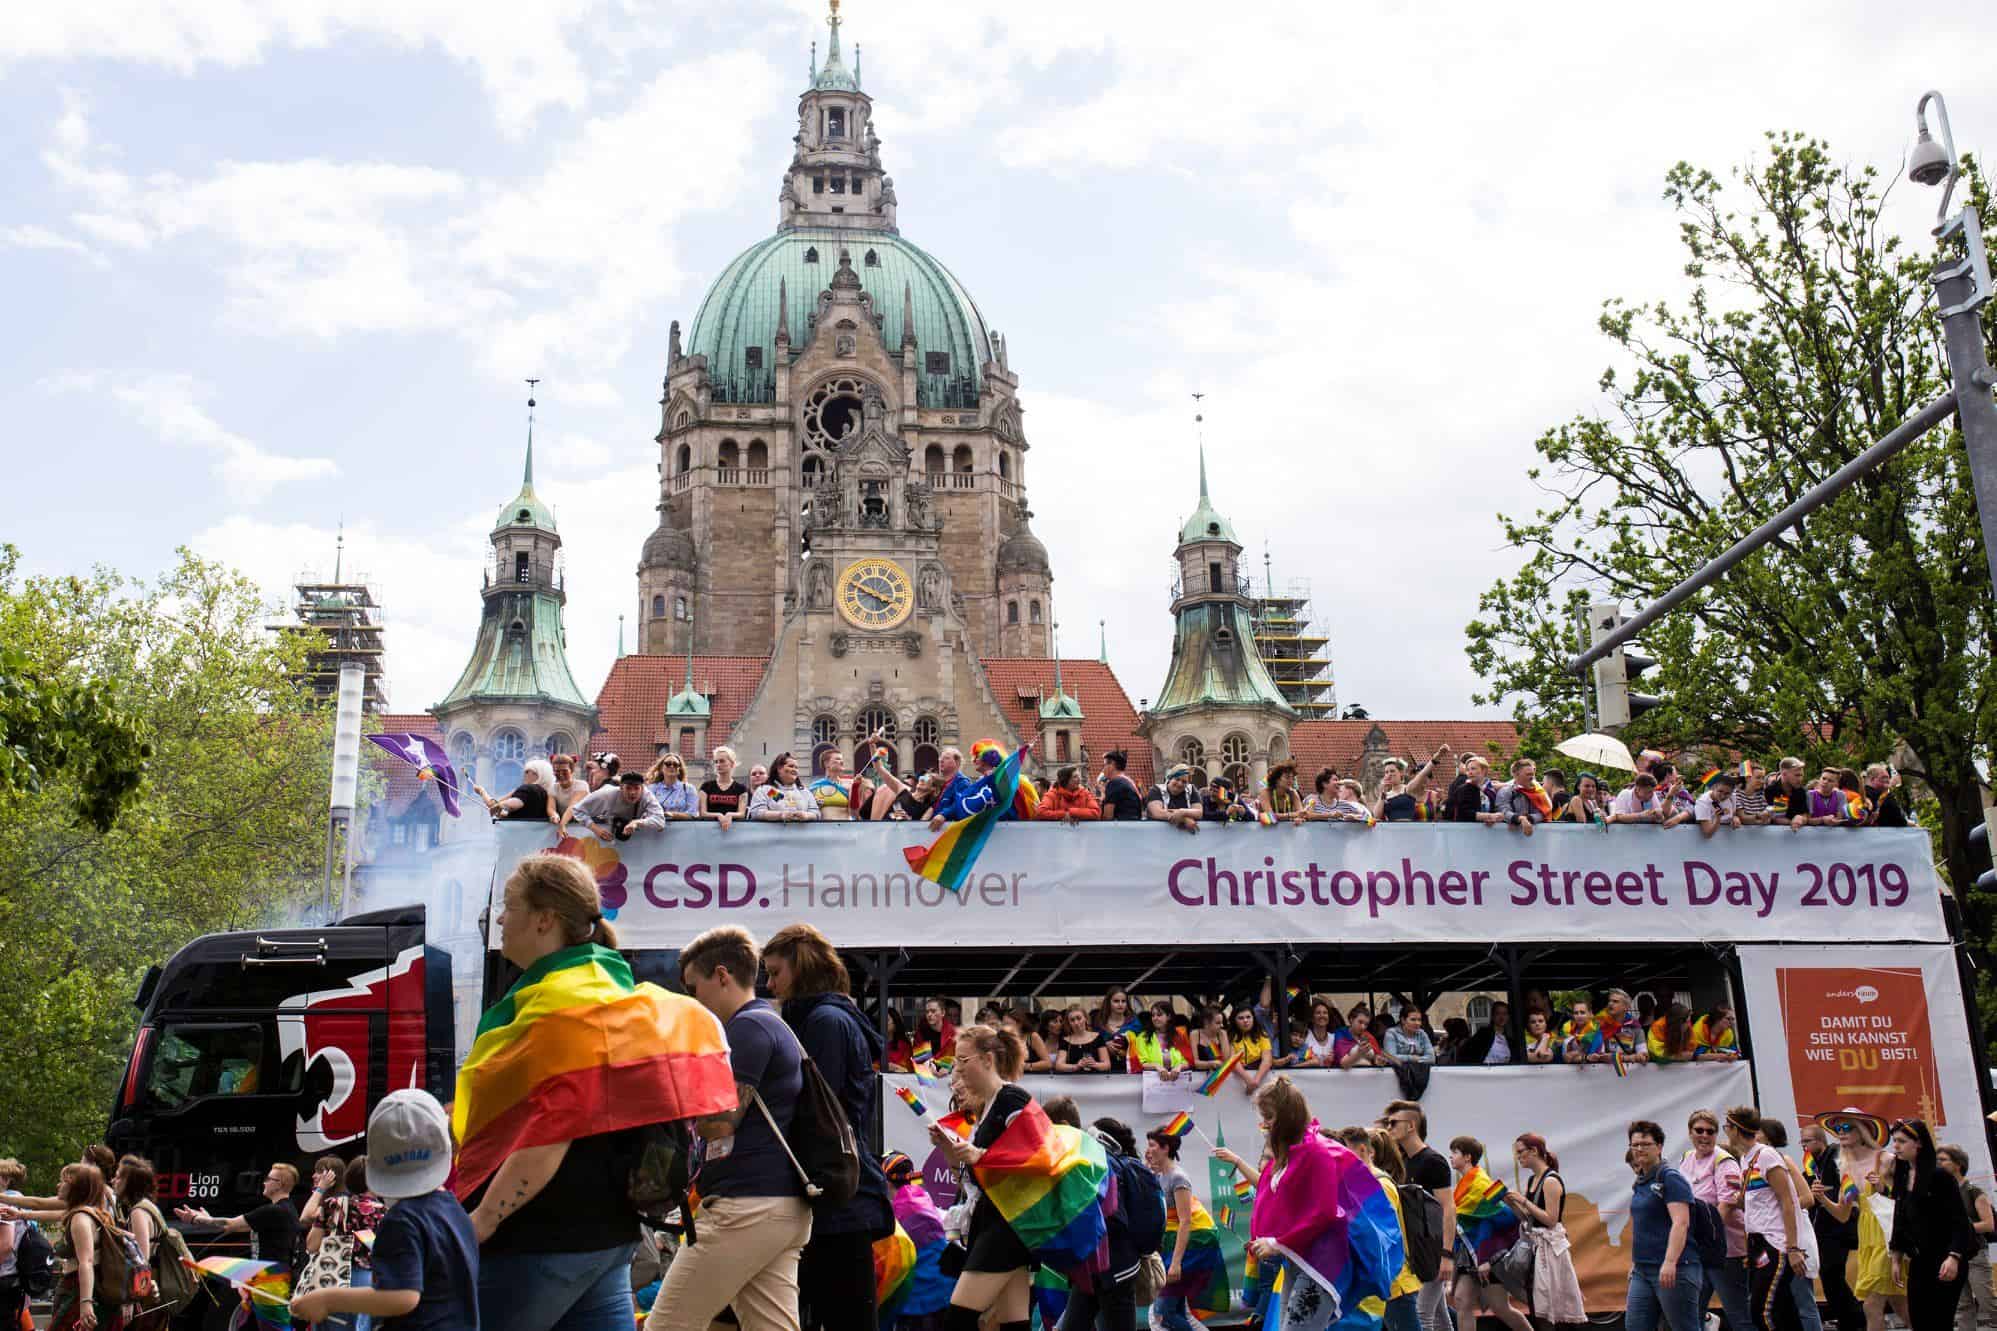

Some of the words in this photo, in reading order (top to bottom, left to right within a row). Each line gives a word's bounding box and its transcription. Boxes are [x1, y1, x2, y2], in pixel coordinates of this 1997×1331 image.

[644, 863, 769, 910] CSD.
[781, 862, 1028, 909] Hannover
[1167, 855, 1489, 919] Christopher
[1507, 859, 1667, 907] Street
[1683, 860, 1780, 919] Day
[1795, 863, 1910, 908] 2019
[1821, 1015, 1868, 1029] DAMIT
[1871, 1015, 1893, 1029] DU
[1810, 1032, 1845, 1045] SEIN
[1848, 1031, 1908, 1045] KANNST
[1804, 1048, 1836, 1061] WIE
[1839, 1048, 1879, 1071] DU
[1881, 1047, 1918, 1061] BIST!
[152, 1172, 190, 1199] ED
[189, 1172, 220, 1185] Lion
[187, 1185, 220, 1198] 500
